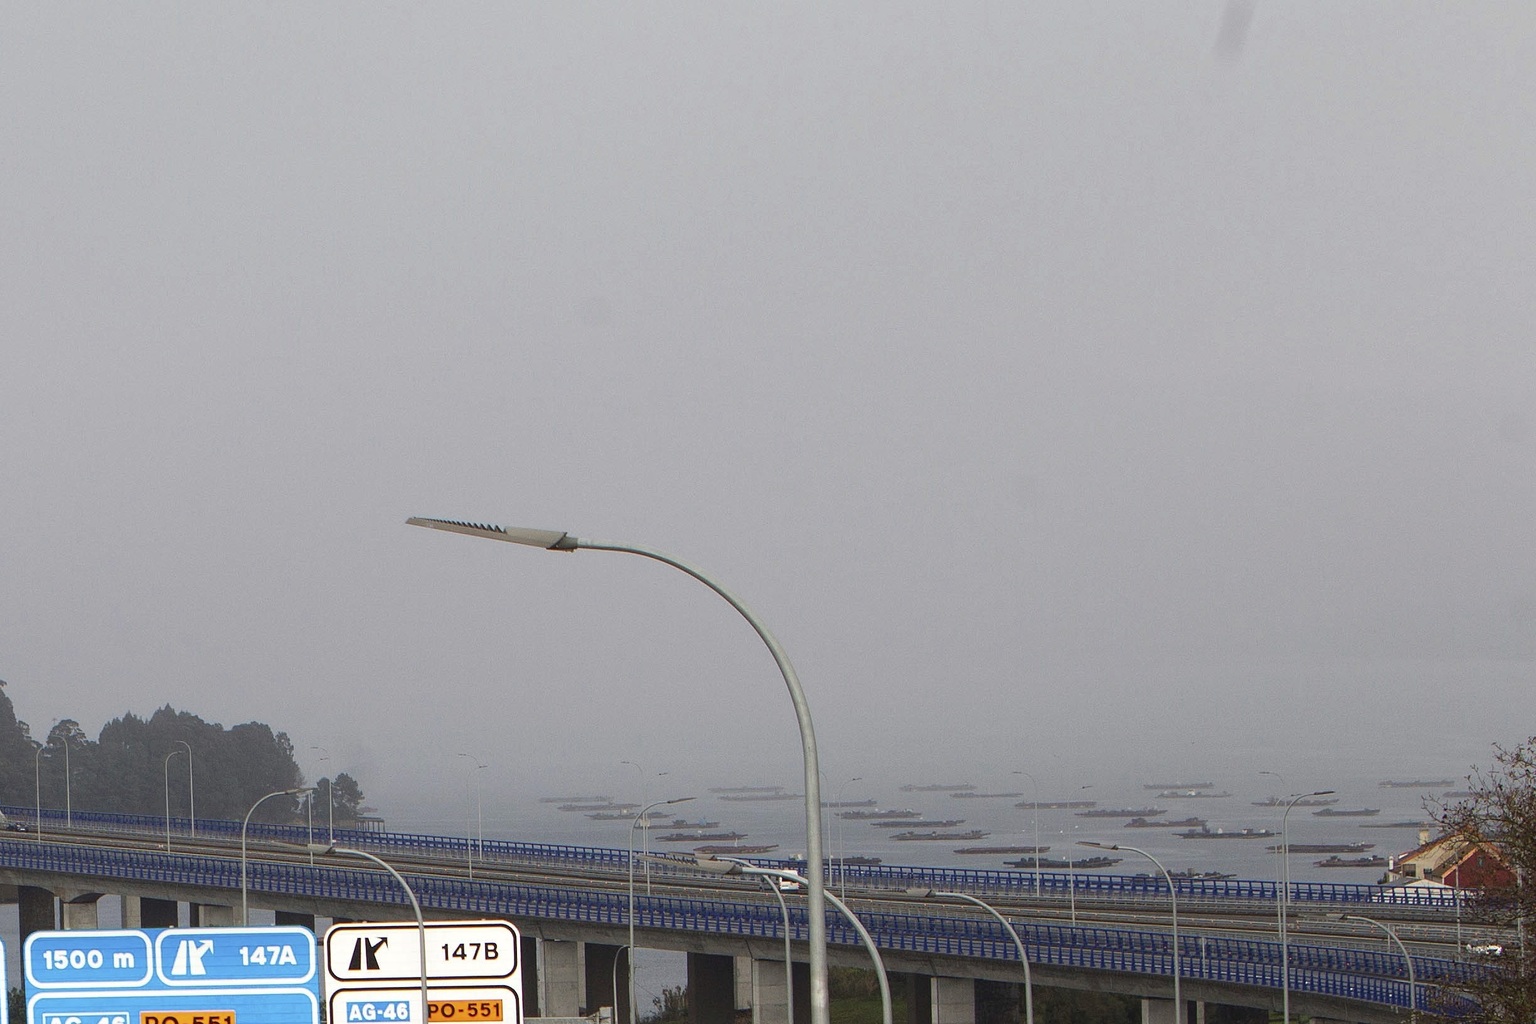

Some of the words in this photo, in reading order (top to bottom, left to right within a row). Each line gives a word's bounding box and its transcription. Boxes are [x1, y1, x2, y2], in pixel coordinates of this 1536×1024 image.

[43, 950, 103, 970] 1500
[114, 952, 134, 969] m
[239, 945, 297, 966] 147A
[441, 942, 499, 961] 147B
[349, 1003, 408, 1020] AG-46
[428, 1003, 500, 1018] PO-551
